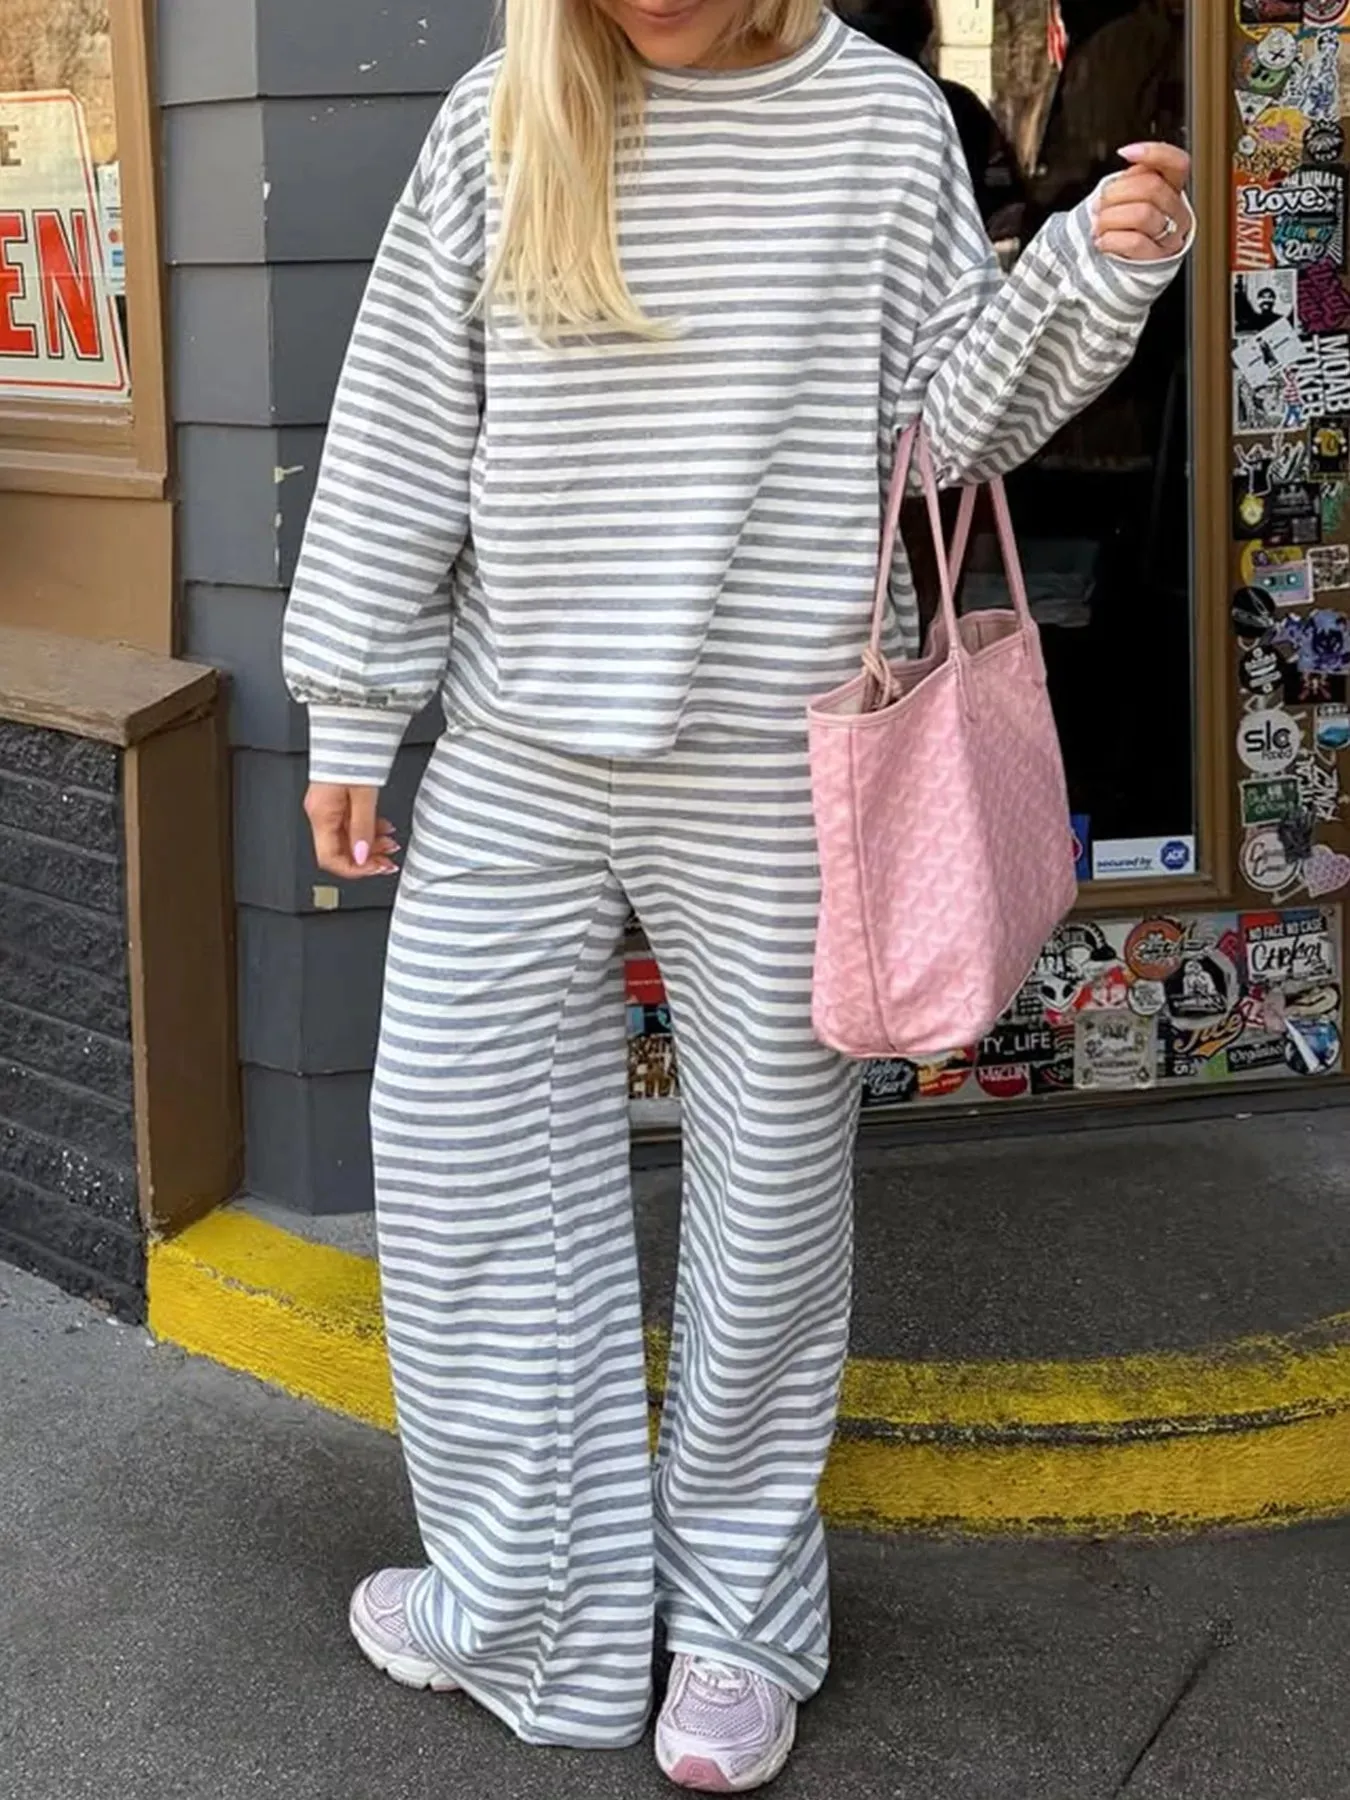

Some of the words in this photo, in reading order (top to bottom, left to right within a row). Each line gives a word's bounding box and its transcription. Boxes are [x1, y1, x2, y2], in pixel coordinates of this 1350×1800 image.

[0, 209, 104, 361] EN
[1319, 334, 1350, 412] MOAB
[1264, 923, 1285, 938] FACE
[1286, 922, 1299, 935] NO
[1301, 918, 1324, 932] CASE
